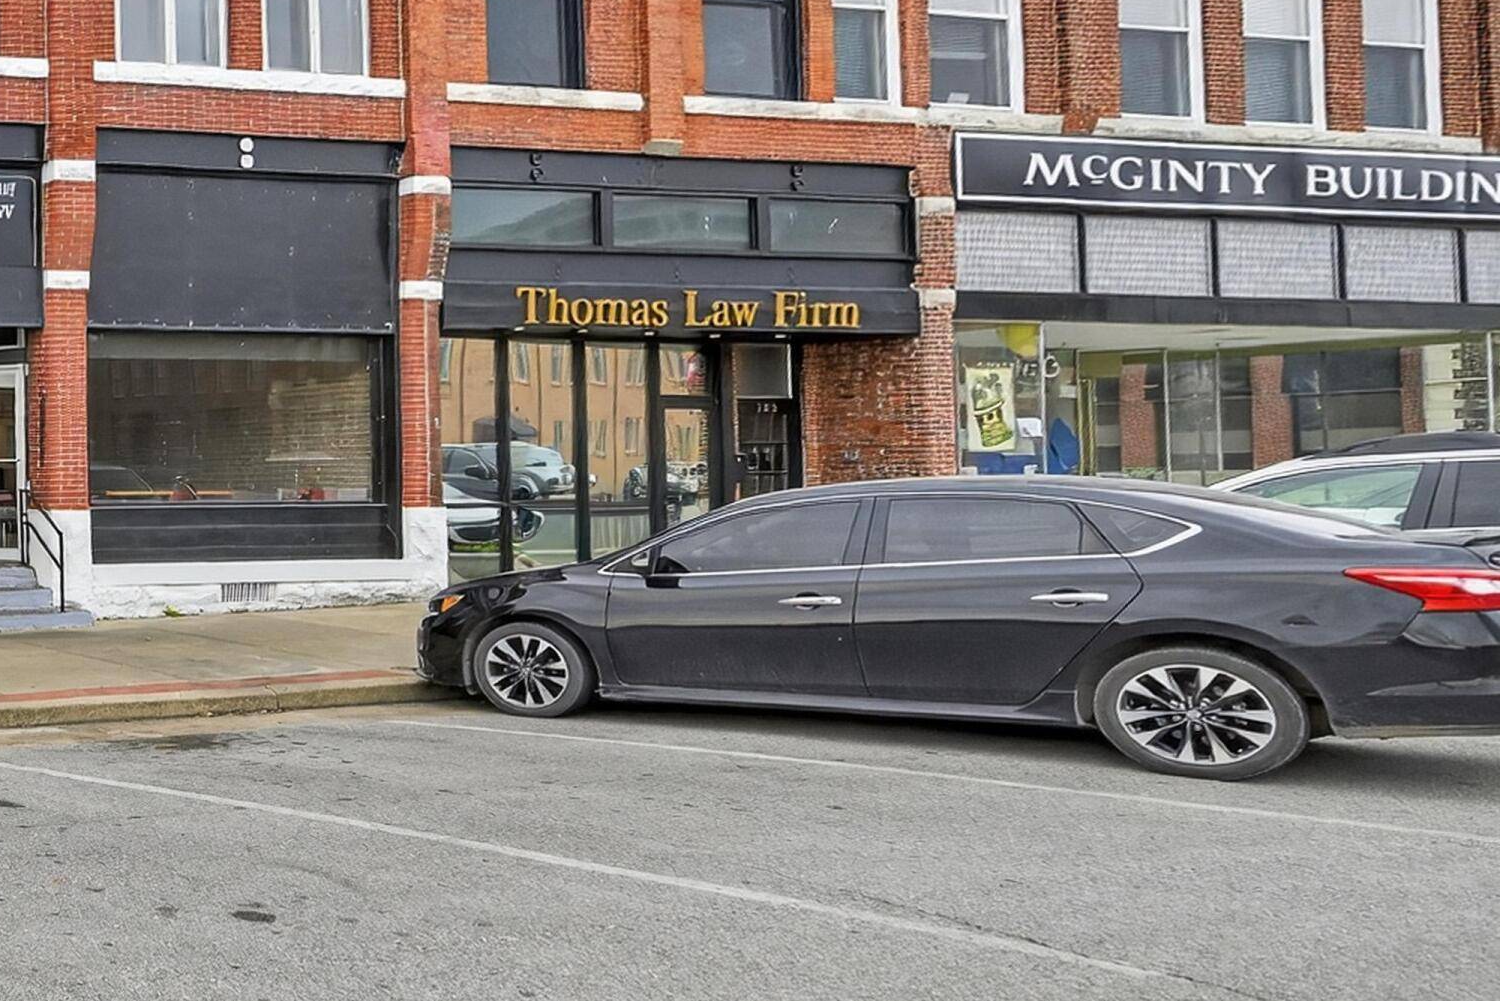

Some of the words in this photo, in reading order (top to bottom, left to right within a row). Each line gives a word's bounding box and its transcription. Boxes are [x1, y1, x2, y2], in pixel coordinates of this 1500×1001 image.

[515, 286, 670, 327] Thomas
[682, 289, 762, 328] Law
[772, 290, 862, 328] Firm
